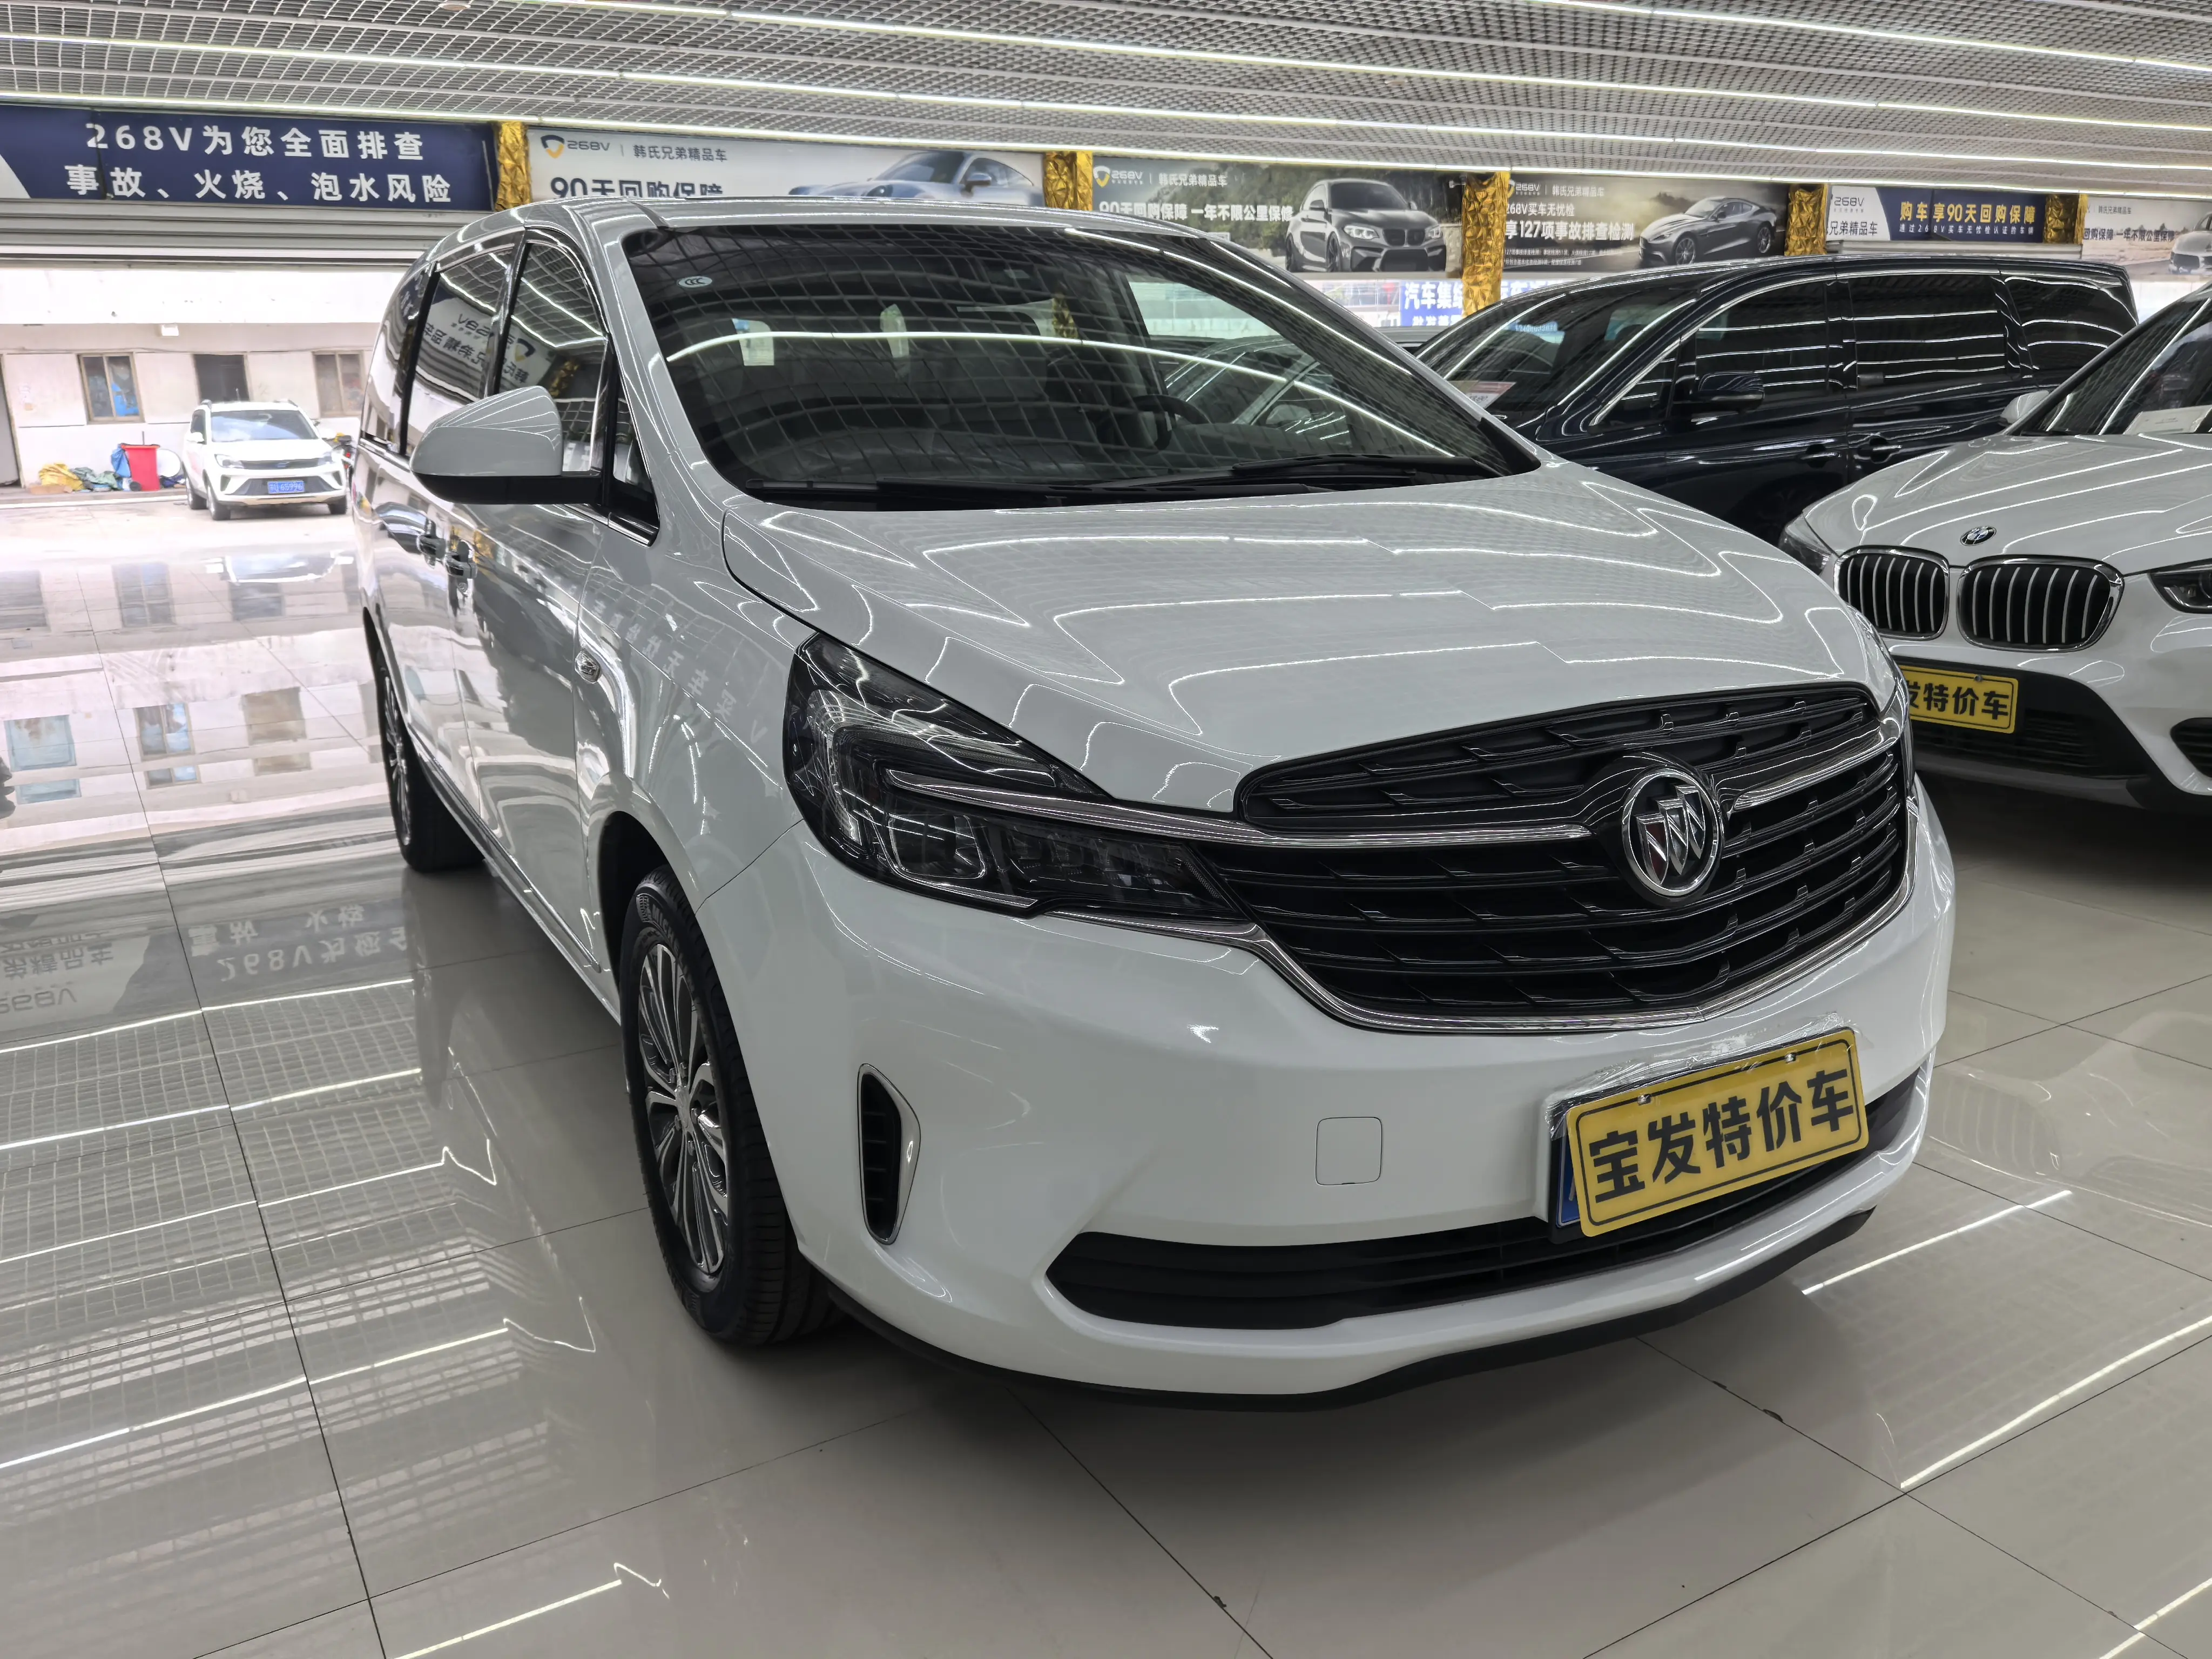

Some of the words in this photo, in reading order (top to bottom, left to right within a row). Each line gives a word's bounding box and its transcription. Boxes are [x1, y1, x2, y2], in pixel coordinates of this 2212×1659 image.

[86, 124, 424, 161] 268V为您全面排查
[567, 140, 610, 151] 268V
[633, 145, 728, 162] 韩氏兄弟精品车
[65, 164, 451, 204] 事故、火烧、泡水风险
[1111, 170, 1143, 180] 268V
[1159, 173, 1228, 187] 韩氏兄弟精品车
[1516, 183, 1540, 192] 268V
[1834, 196, 1865, 207] 268V
[1900, 201, 2035, 224] 购车享90天回购保障
[1191, 204, 1293, 222] 一年不限公里保修
[1505, 219, 1635, 241] 享127项事故排查检测
[1827, 220, 1878, 236] 兄弟精品车
[1589, 1069, 1854, 1204] 宝发特价车
